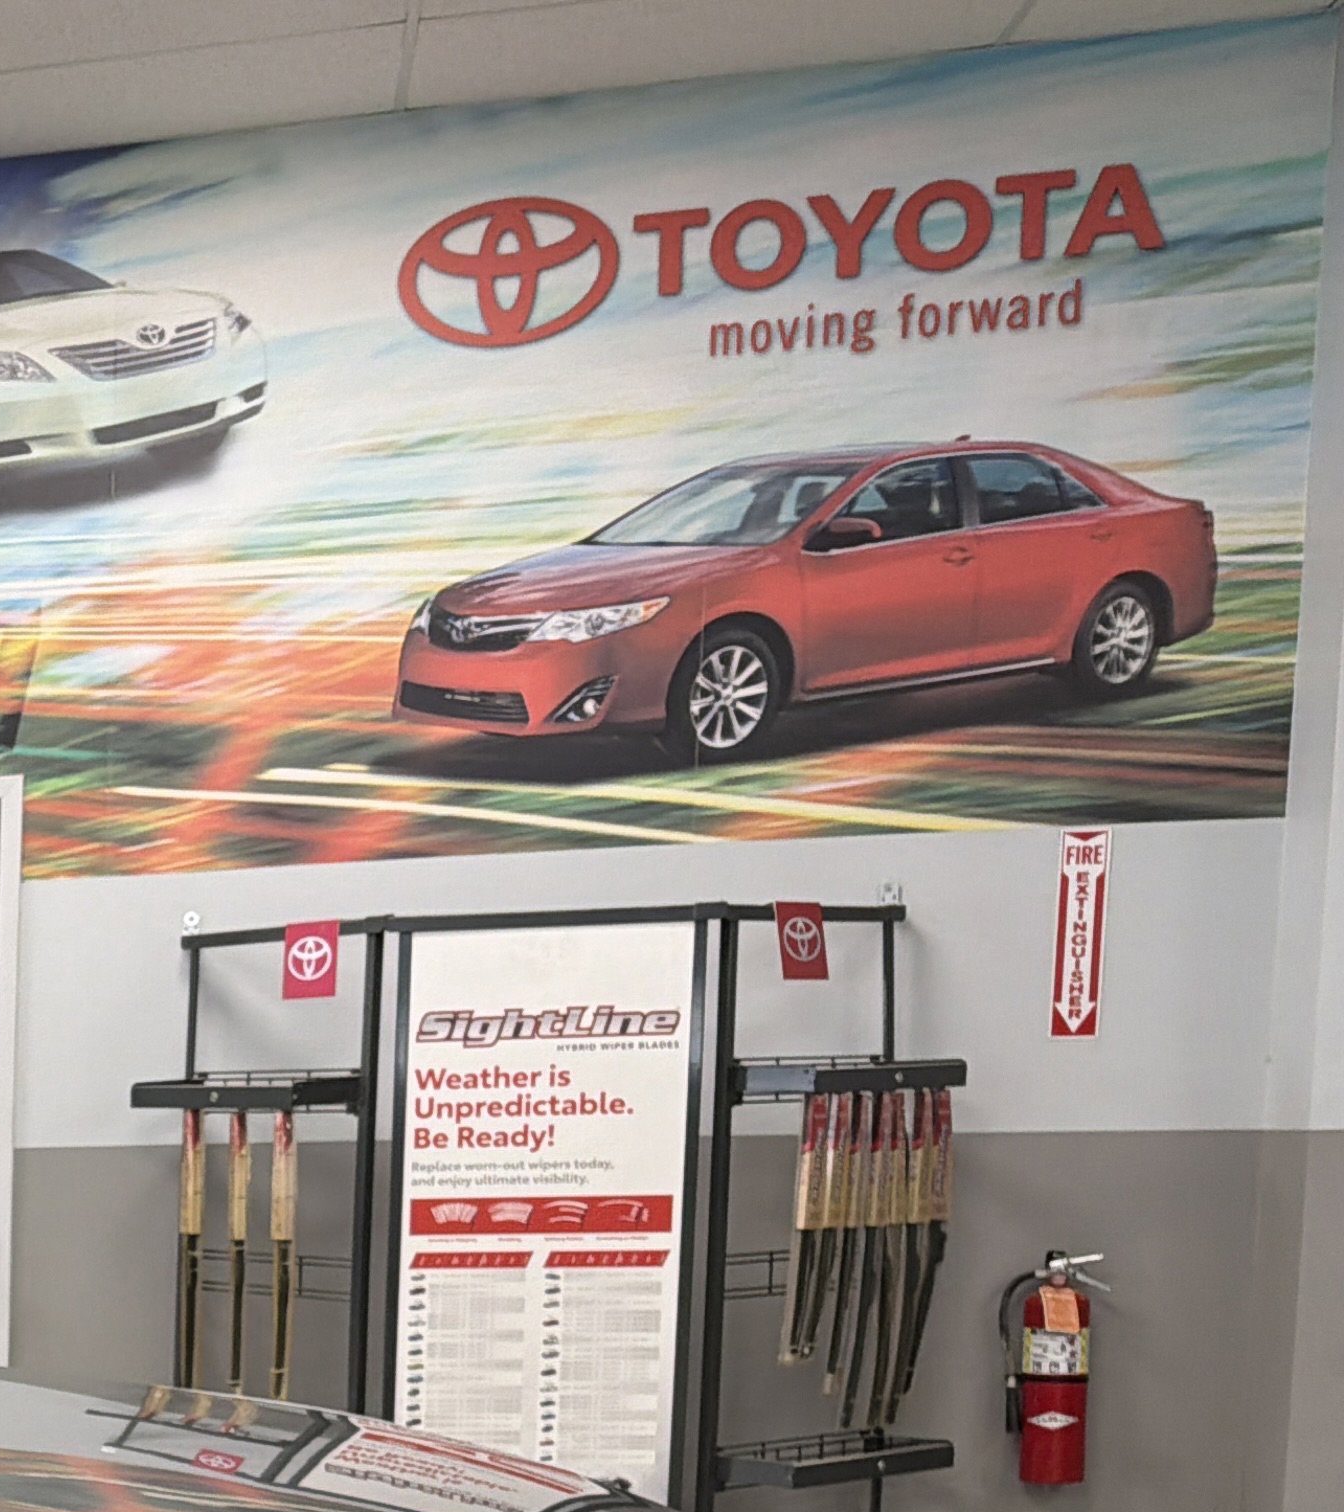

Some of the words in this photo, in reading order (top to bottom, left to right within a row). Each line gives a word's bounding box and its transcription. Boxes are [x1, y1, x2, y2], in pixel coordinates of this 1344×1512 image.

[633, 162, 1166, 297] TOYOTA
[709, 304, 878, 358] moving
[898, 279, 1084, 340] forward
[1065, 844, 1104, 866] FIRE
[1067, 870, 1090, 1020] EXTINGUISHER
[415, 1005, 682, 1049] SightLine
[414, 1065, 542, 1091] Weather
[548, 1063, 571, 1088] is
[414, 1091, 635, 1124] Unpredictable.
[413, 1126, 449, 1149] Be
[457, 1123, 555, 1153] Ready!
[410, 1175, 436, 1187] and
[439, 1175, 472, 1189] enjoy
[475, 1173, 530, 1186] ultimate
[533, 1172, 590, 1186] visibility.
[411, 1161, 462, 1174] Replace
[464, 1160, 525, 1172] worn-out
[528, 1158, 571, 1172] wipers
